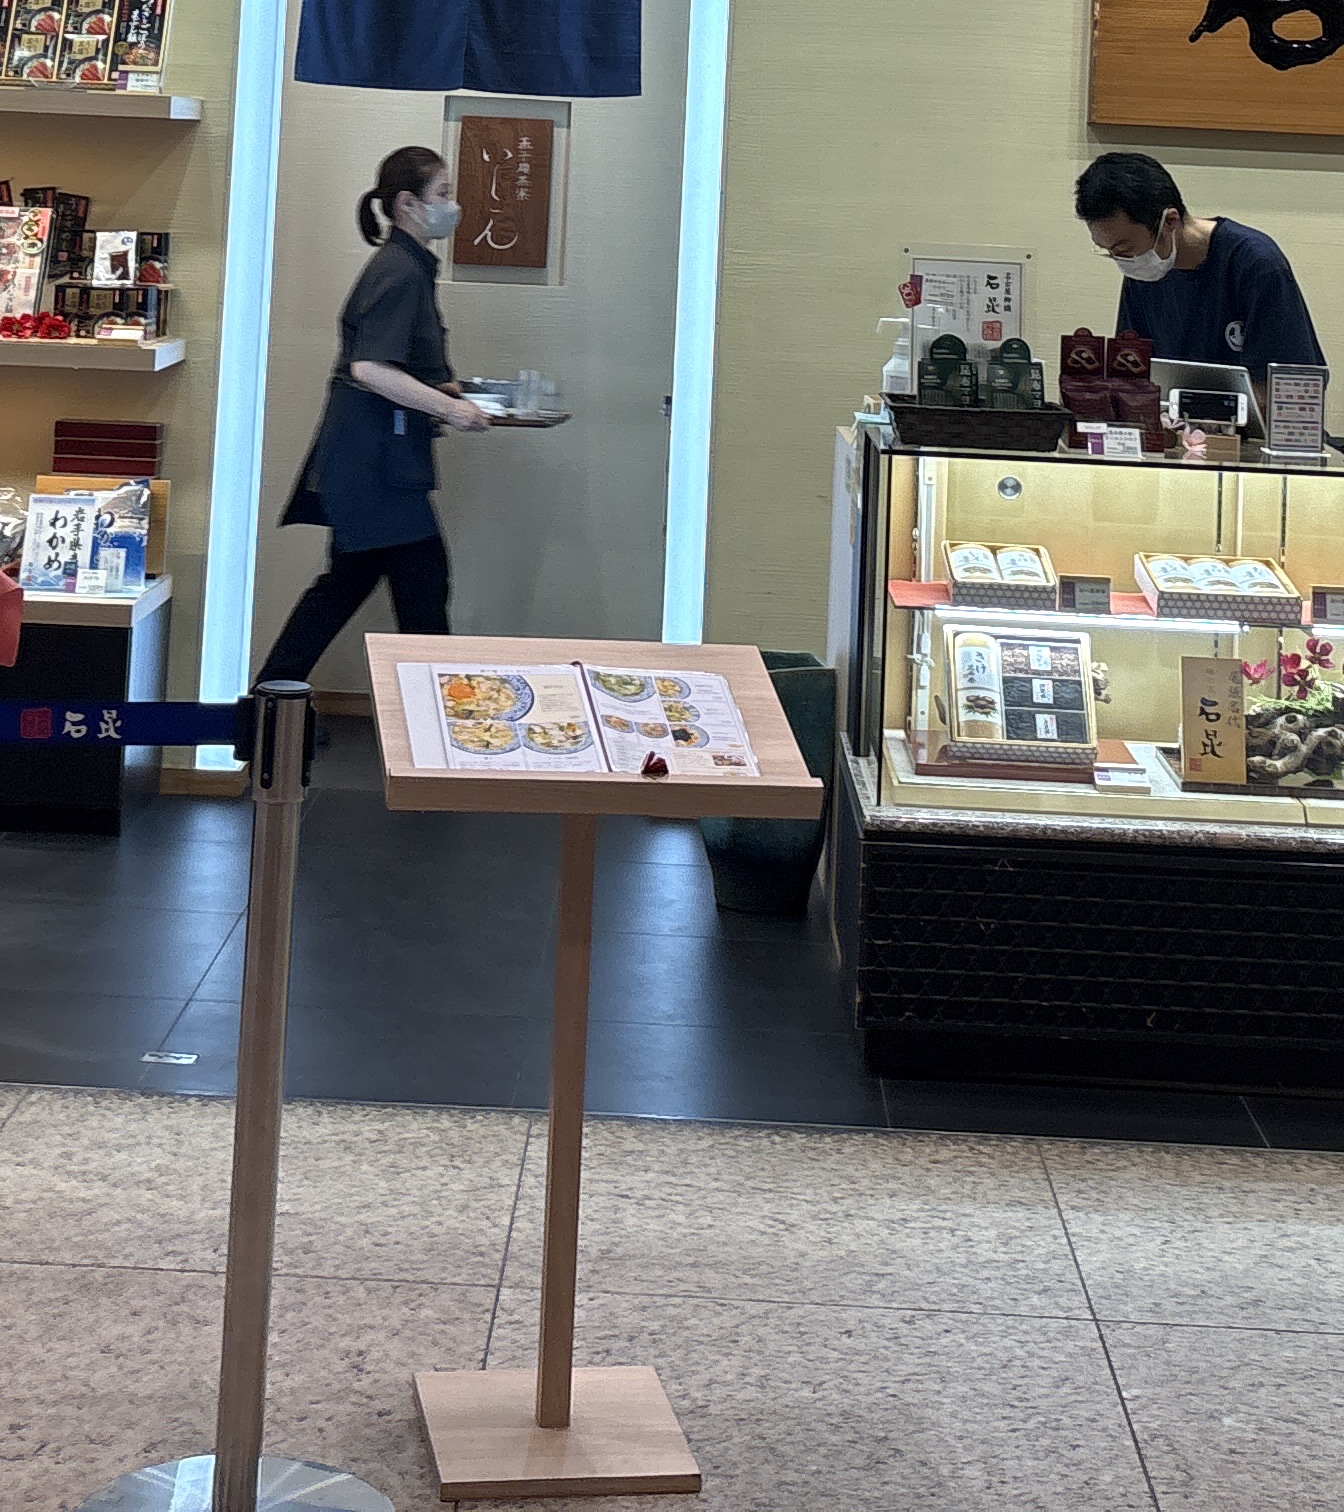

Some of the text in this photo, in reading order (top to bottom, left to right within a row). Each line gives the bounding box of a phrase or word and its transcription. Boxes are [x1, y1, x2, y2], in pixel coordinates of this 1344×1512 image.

[984, 273, 1001, 314] 石昆
[42, 509, 68, 572] わかめ
[61, 709, 124, 739] 石昆
[1198, 696, 1224, 759] 石昆
